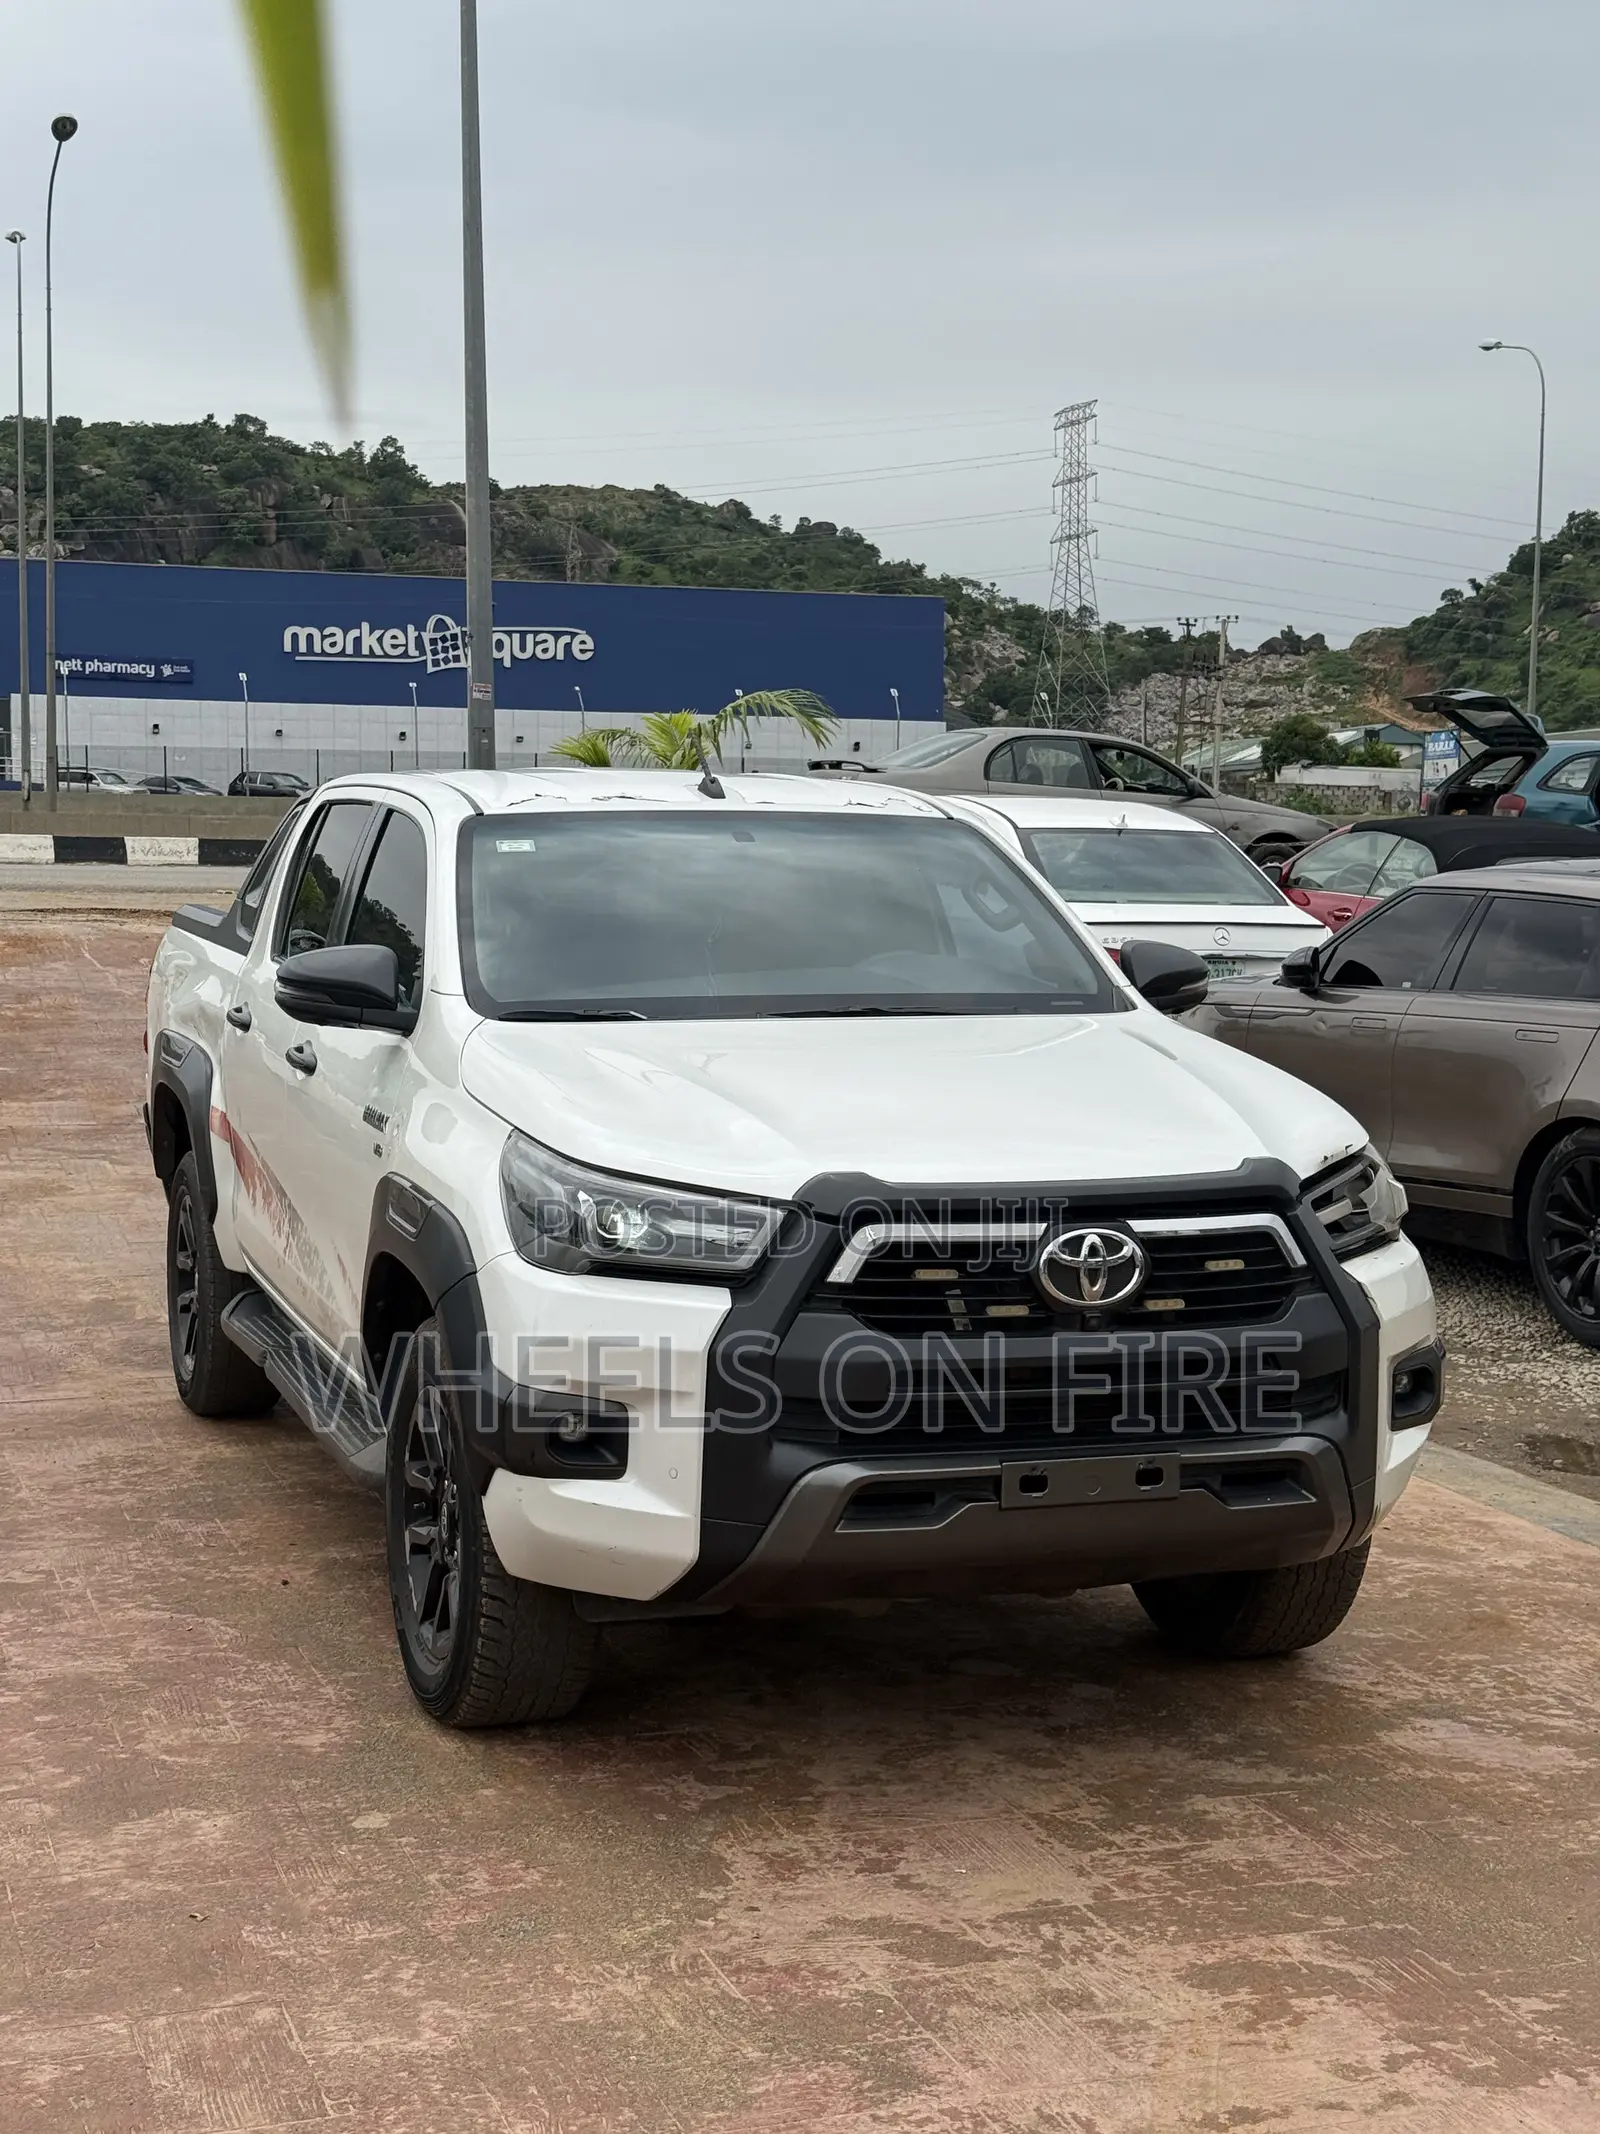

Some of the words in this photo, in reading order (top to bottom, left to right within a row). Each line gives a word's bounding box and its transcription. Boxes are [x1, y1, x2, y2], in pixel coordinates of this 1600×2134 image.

[283, 621, 419, 657] market
[465, 632, 595, 668] quare
[85, 659, 155, 678] pharmacy
